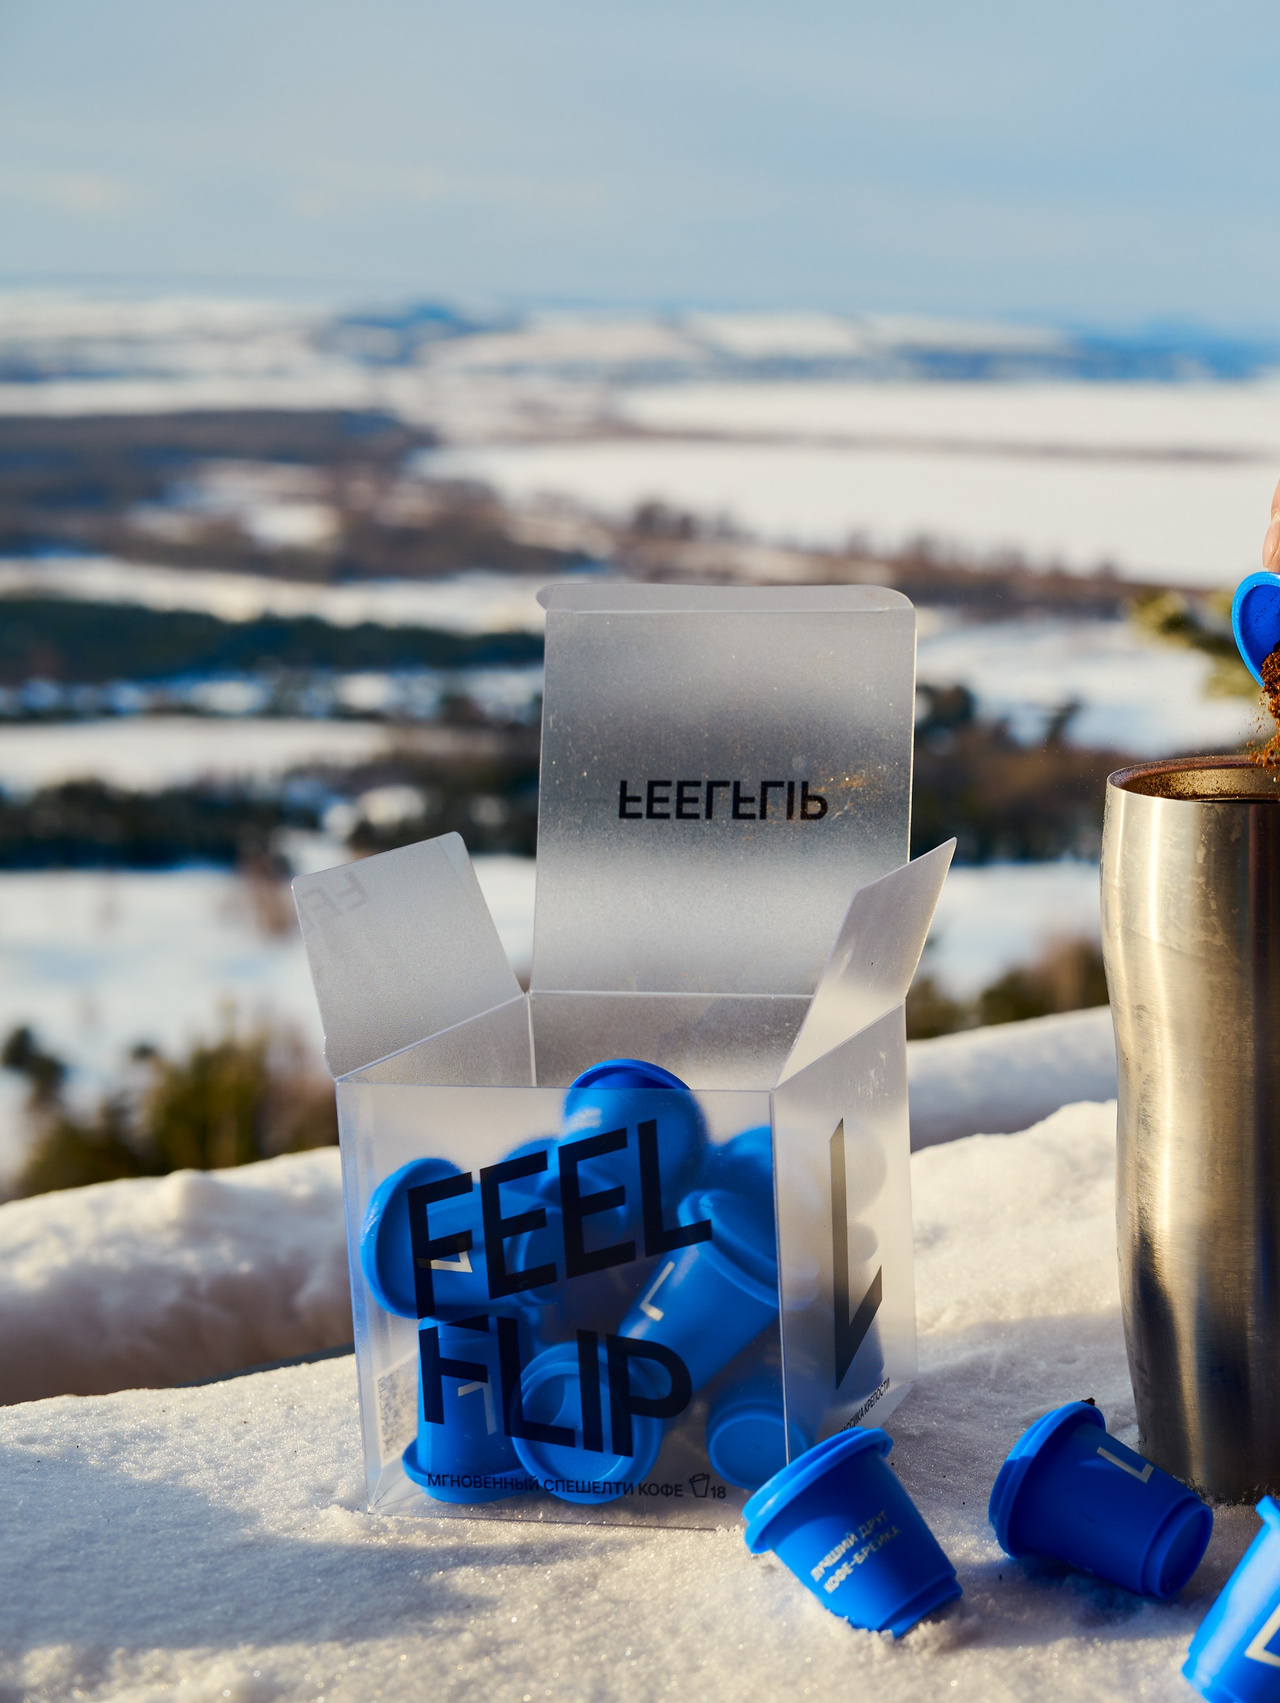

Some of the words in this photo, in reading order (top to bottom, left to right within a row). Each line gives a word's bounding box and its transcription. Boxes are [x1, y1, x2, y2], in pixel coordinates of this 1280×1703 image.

[408, 1118, 712, 1320] FEEL
[829, 1117, 883, 1390] L
[418, 1314, 692, 1457] FLIP
[864, 1377, 890, 1413] КРЕПОСТИ
[427, 1473, 540, 1492] МГНОВЕННЫЙ
[543, 1479, 634, 1496] СПЕШЕЛТИ
[638, 1483, 683, 1498] КОФЕ
[710, 1486, 727, 1499] 18
[1096, 1446, 1154, 1483] L
[810, 1532, 858, 1582] ЛУЧШИЙ
[859, 1509, 887, 1538] ДРУГ
